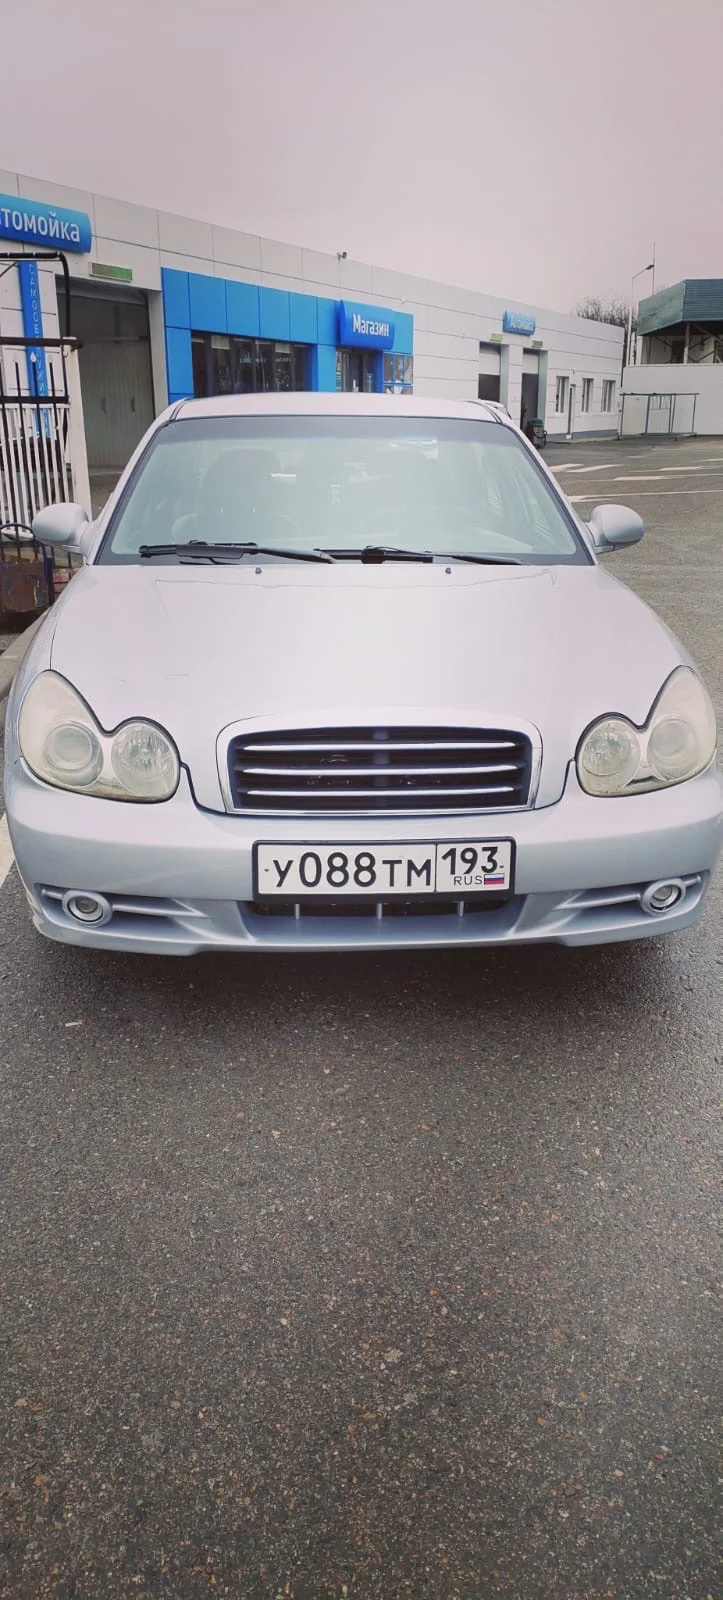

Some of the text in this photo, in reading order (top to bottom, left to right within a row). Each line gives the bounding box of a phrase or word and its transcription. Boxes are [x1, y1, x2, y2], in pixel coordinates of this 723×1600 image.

[0, 208, 80, 242] томойка
[352, 312, 390, 337] Магазин
[272, 846, 498, 888] У088ТМ 193
[453, 875, 483, 886] RUS
